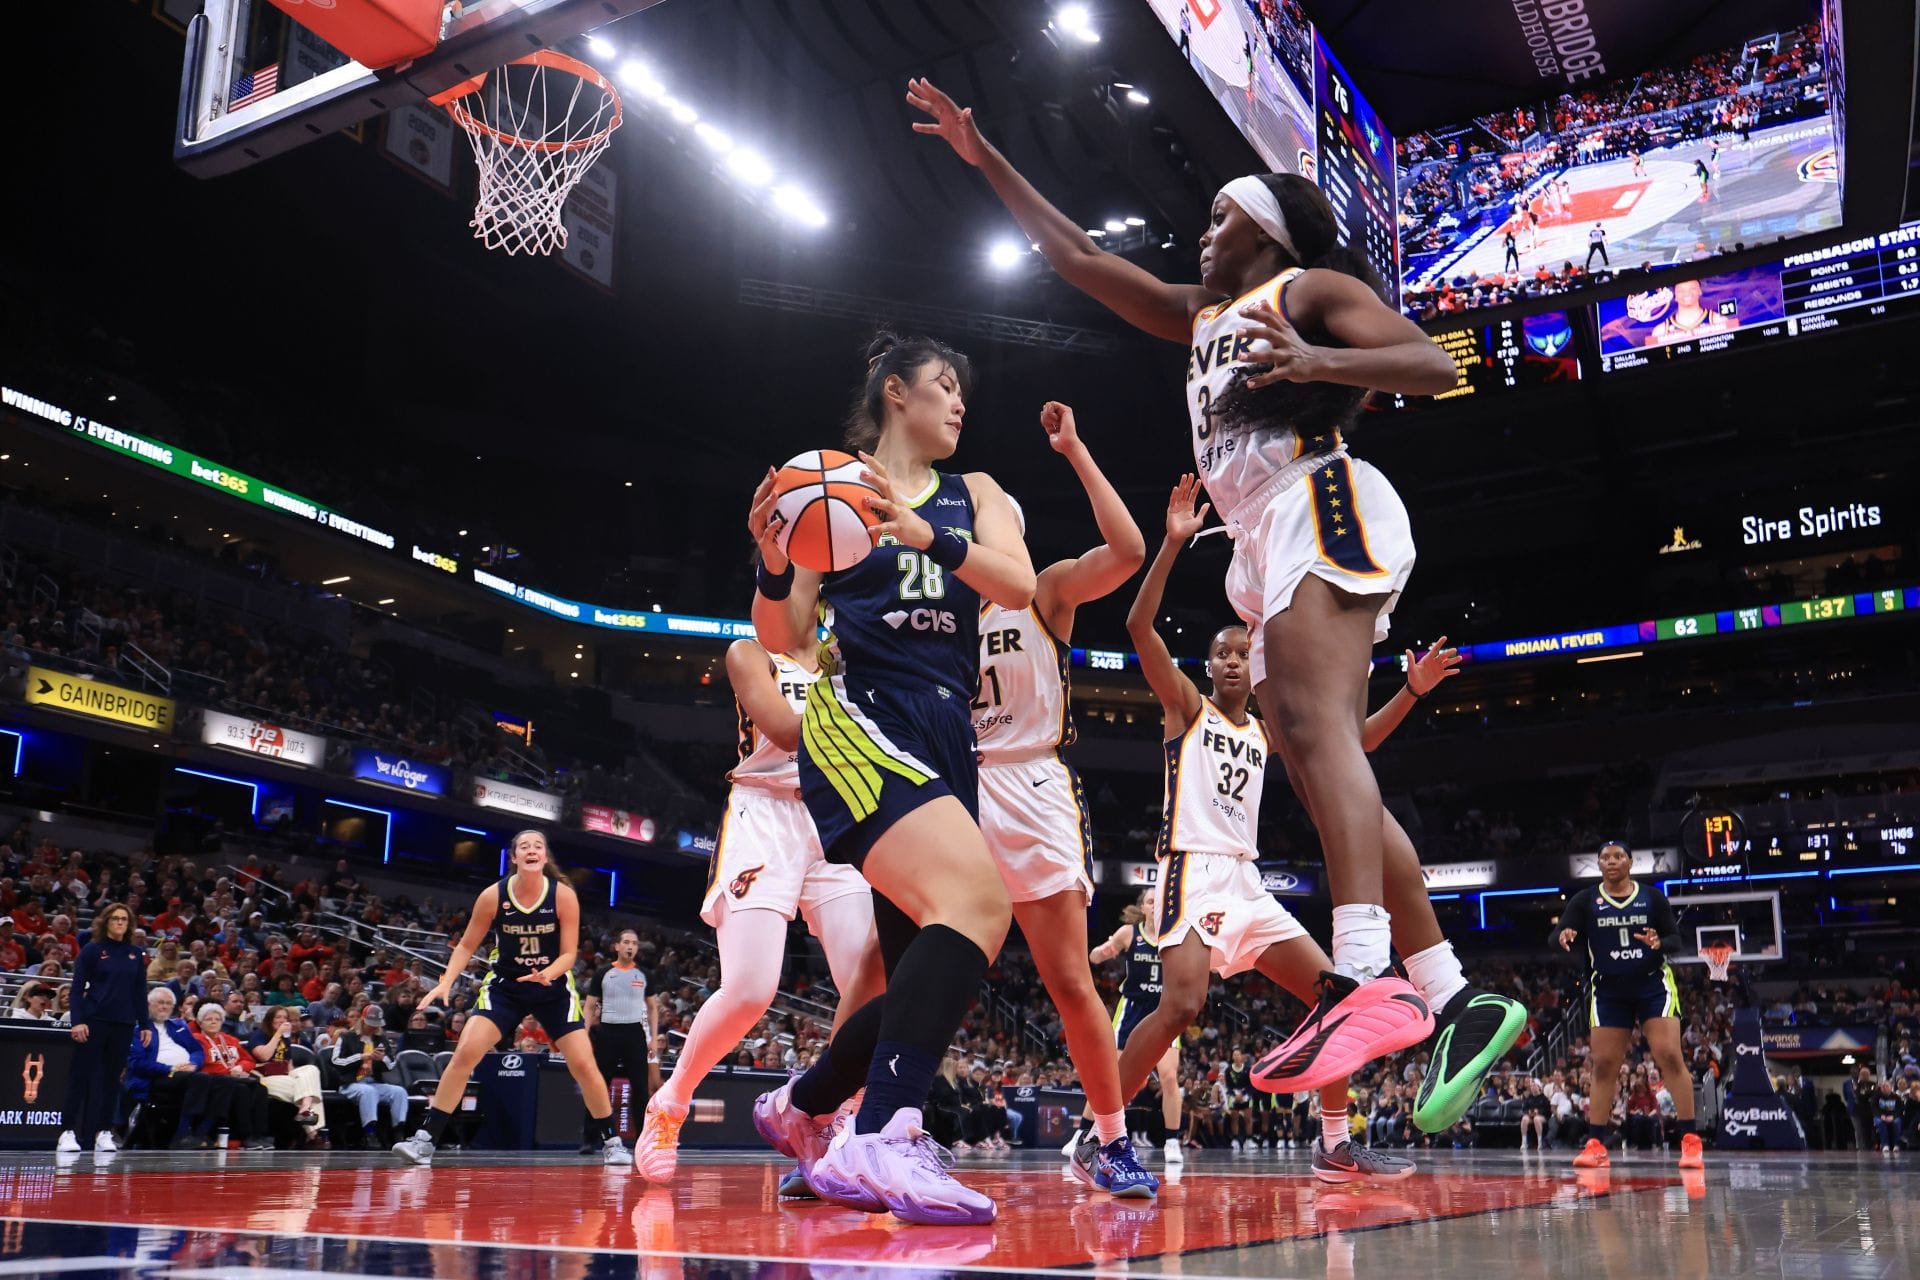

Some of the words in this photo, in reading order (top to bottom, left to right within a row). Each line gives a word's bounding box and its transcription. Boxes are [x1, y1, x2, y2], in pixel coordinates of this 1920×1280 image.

[1512, 0, 1559, 77] LDHOUSE
[1332, 74, 1348, 114] 76
[1810, 262, 1849, 277] POINTS
[1810, 277, 1853, 293] ASSISTS
[1804, 291, 1862, 310] REBOUNDS
[1, 387, 72, 427] WINNING
[73, 416, 87, 432] IS
[88, 421, 173, 465] EVERYTHING
[191, 461, 248, 494] bet365
[263, 488, 317, 520] WINNING
[317, 510, 328, 525] IS
[329, 513, 395, 549] EVERYTHING
[935, 497, 967, 508] Albert
[1742, 515, 1791, 545] Sire
[1799, 503, 1881, 539] Spirits
[898, 552, 945, 600] 28
[412, 546, 458, 573] bet365
[474, 569, 516, 595] WINNING
[516, 586, 525, 599] IS
[525, 588, 580, 618] EVERYTHING
[594, 610, 646, 628] bet365
[668, 617, 720, 634] WINNING
[722, 623, 731, 635] IS
[1802, 598, 1845, 620] 1:37
[1884, 598, 1894, 610] 3
[910, 608, 957, 633] CVS
[1674, 618, 1698, 635] 62
[1742, 616, 1757, 630] 11
[1505, 637, 1558, 657] INDIANA
[1561, 631, 1604, 652] FEVER
[60, 683, 167, 725] GAINBRIDGE
[1203, 728, 1263, 769] FEVER
[391, 760, 428, 788] Kroger
[1217, 762, 1249, 802] 32
[1705, 816, 1732, 832] 1:37
[1808, 834, 1828, 848] 1:37
[1881, 827, 1914, 840] WINGS
[1891, 842, 1906, 855] 76
[1704, 865, 1741, 876] TISSOT
[1262, 874, 1289, 888] Ford
[503, 923, 555, 935] DALLAS
[1597, 915, 1647, 927] DALLAS
[1620, 928, 1629, 947] 0
[520, 937, 540, 955] 20
[1621, 949, 1643, 959] CVS
[525, 956, 550, 966] CVS
[1763, 1034, 1800, 1043] evance
[1776, 1041, 1801, 1049] Health
[0, 1111, 22, 1125] ARK
[1724, 1107, 1788, 1123] KeyBank
